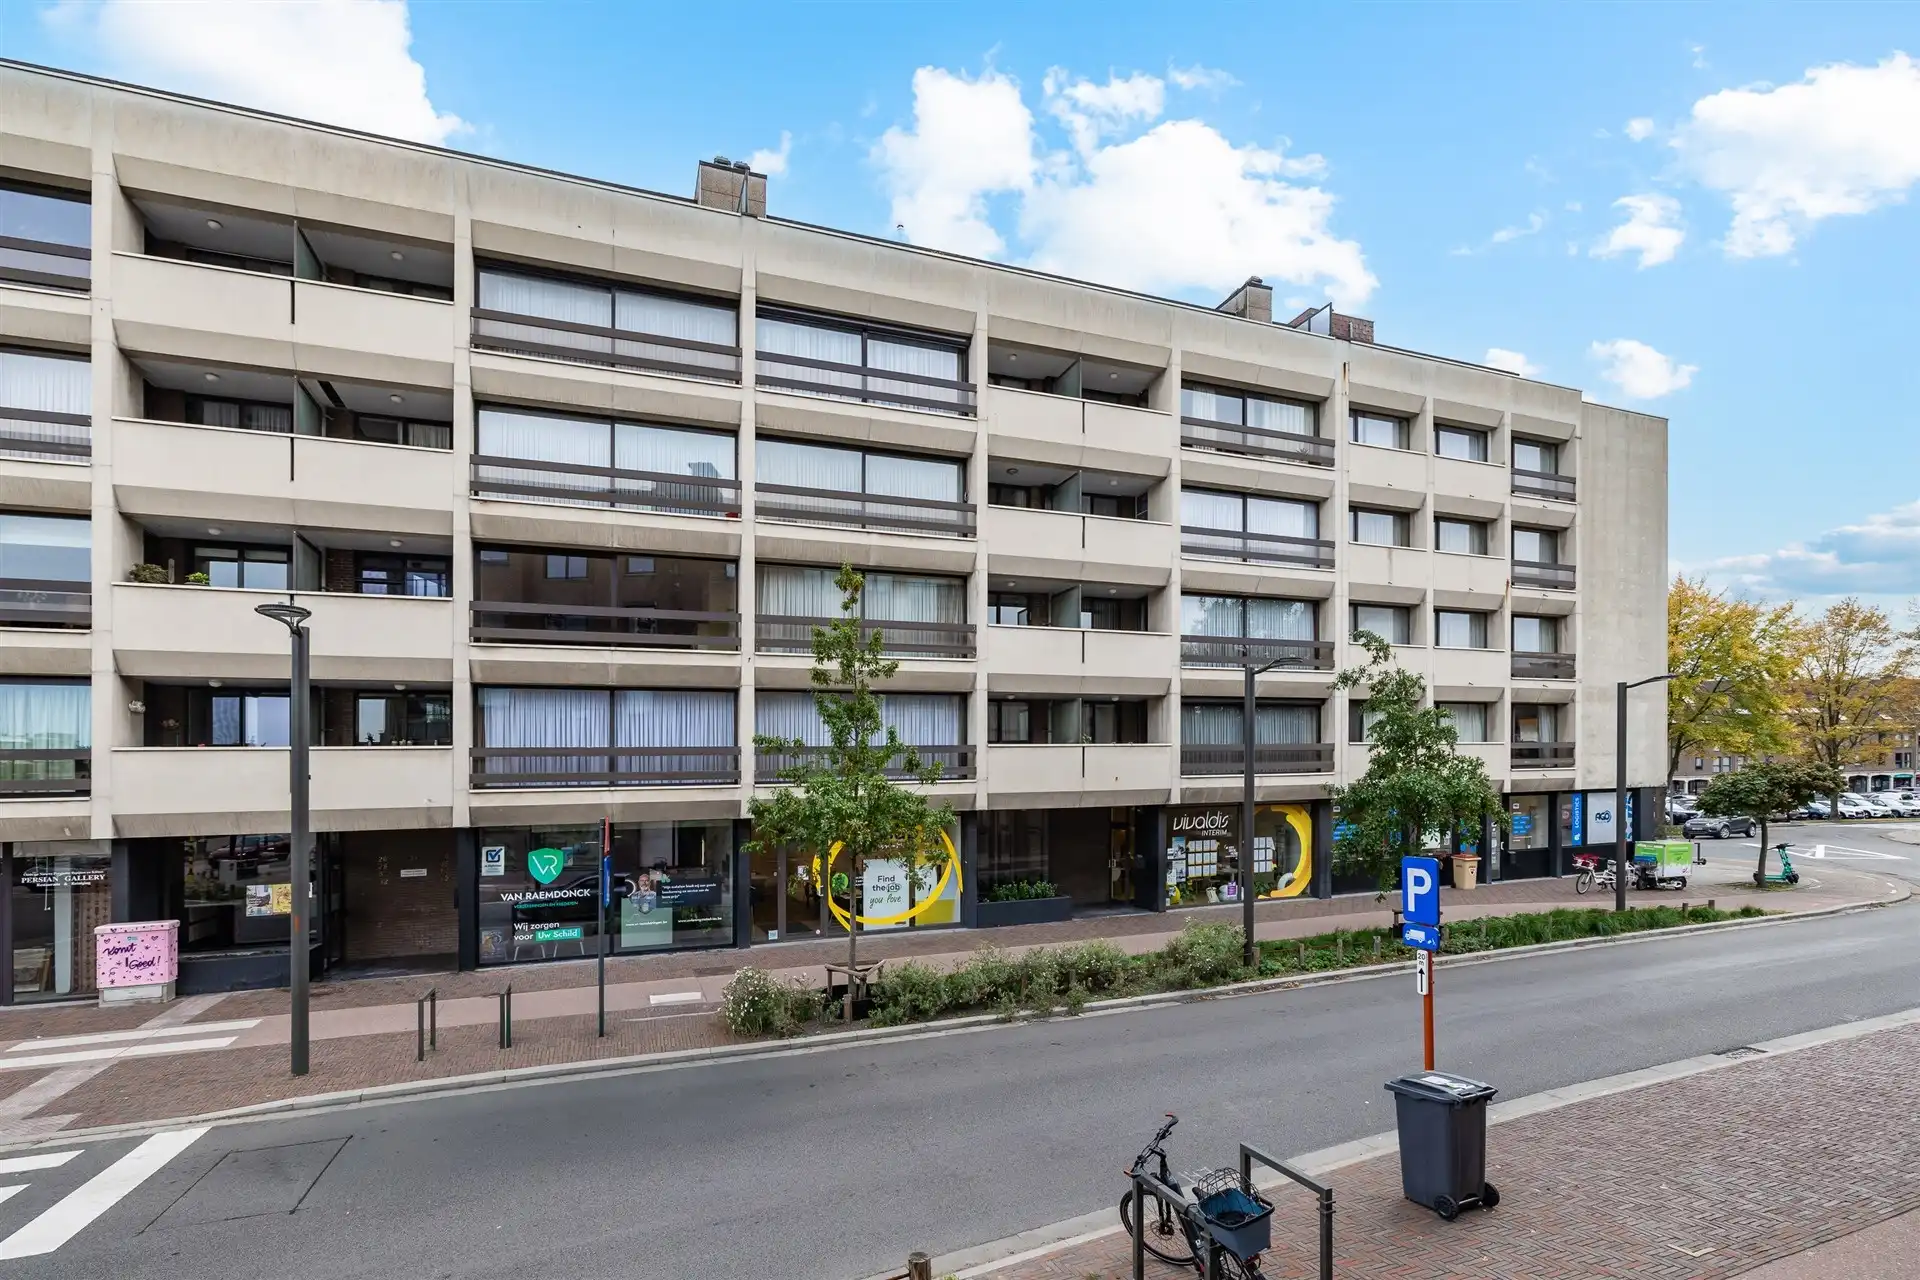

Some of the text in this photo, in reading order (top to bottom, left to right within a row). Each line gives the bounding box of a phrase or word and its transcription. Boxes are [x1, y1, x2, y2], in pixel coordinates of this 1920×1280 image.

[1173, 810, 1229, 831] vivaldis
[1201, 829, 1228, 837] INTERIM
[21, 875, 59, 884] PERSIAN
[64, 873, 106, 882] GALLERY
[877, 875, 896, 883] Find
[872, 884, 901, 893] the job
[1406, 867, 1432, 912] P
[500, 888, 591, 902] VAN RAEMDONCK
[869, 893, 902, 910] you love
[513, 921, 560, 931] Wij zorgen
[513, 929, 578, 941] voor Uw Schild
[1417, 952, 1426, 961] 20
